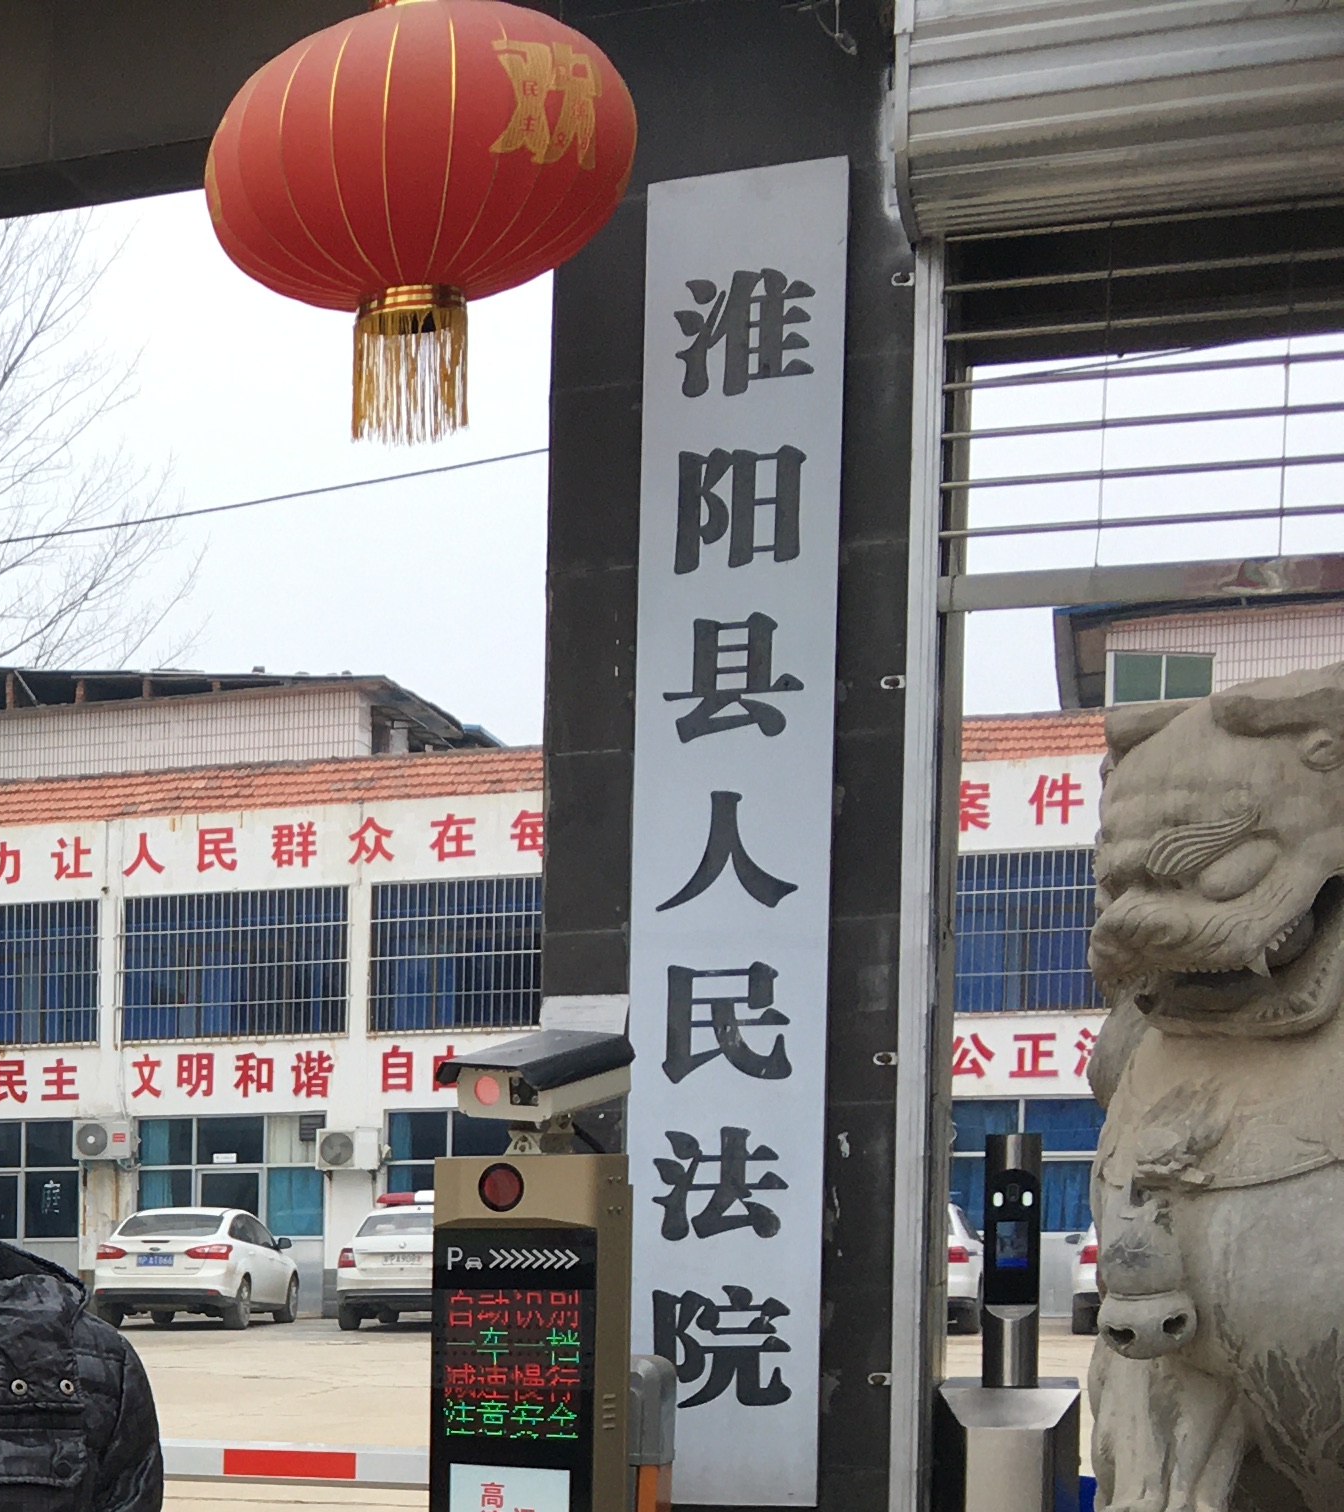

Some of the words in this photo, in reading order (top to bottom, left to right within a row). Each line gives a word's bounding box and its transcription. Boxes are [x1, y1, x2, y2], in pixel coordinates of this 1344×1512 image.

[959, 772, 1085, 832] 案件
[651, 267, 816, 1409] 淮阳县人民法院
[130, 1049, 335, 1099] 文明和谐
[446, 1246, 464, 1271] P
[448, 1290, 580, 1328] 自动识别
[444, 1363, 581, 1403] 减速慢行
[442, 1398, 580, 1440] 注意安全
